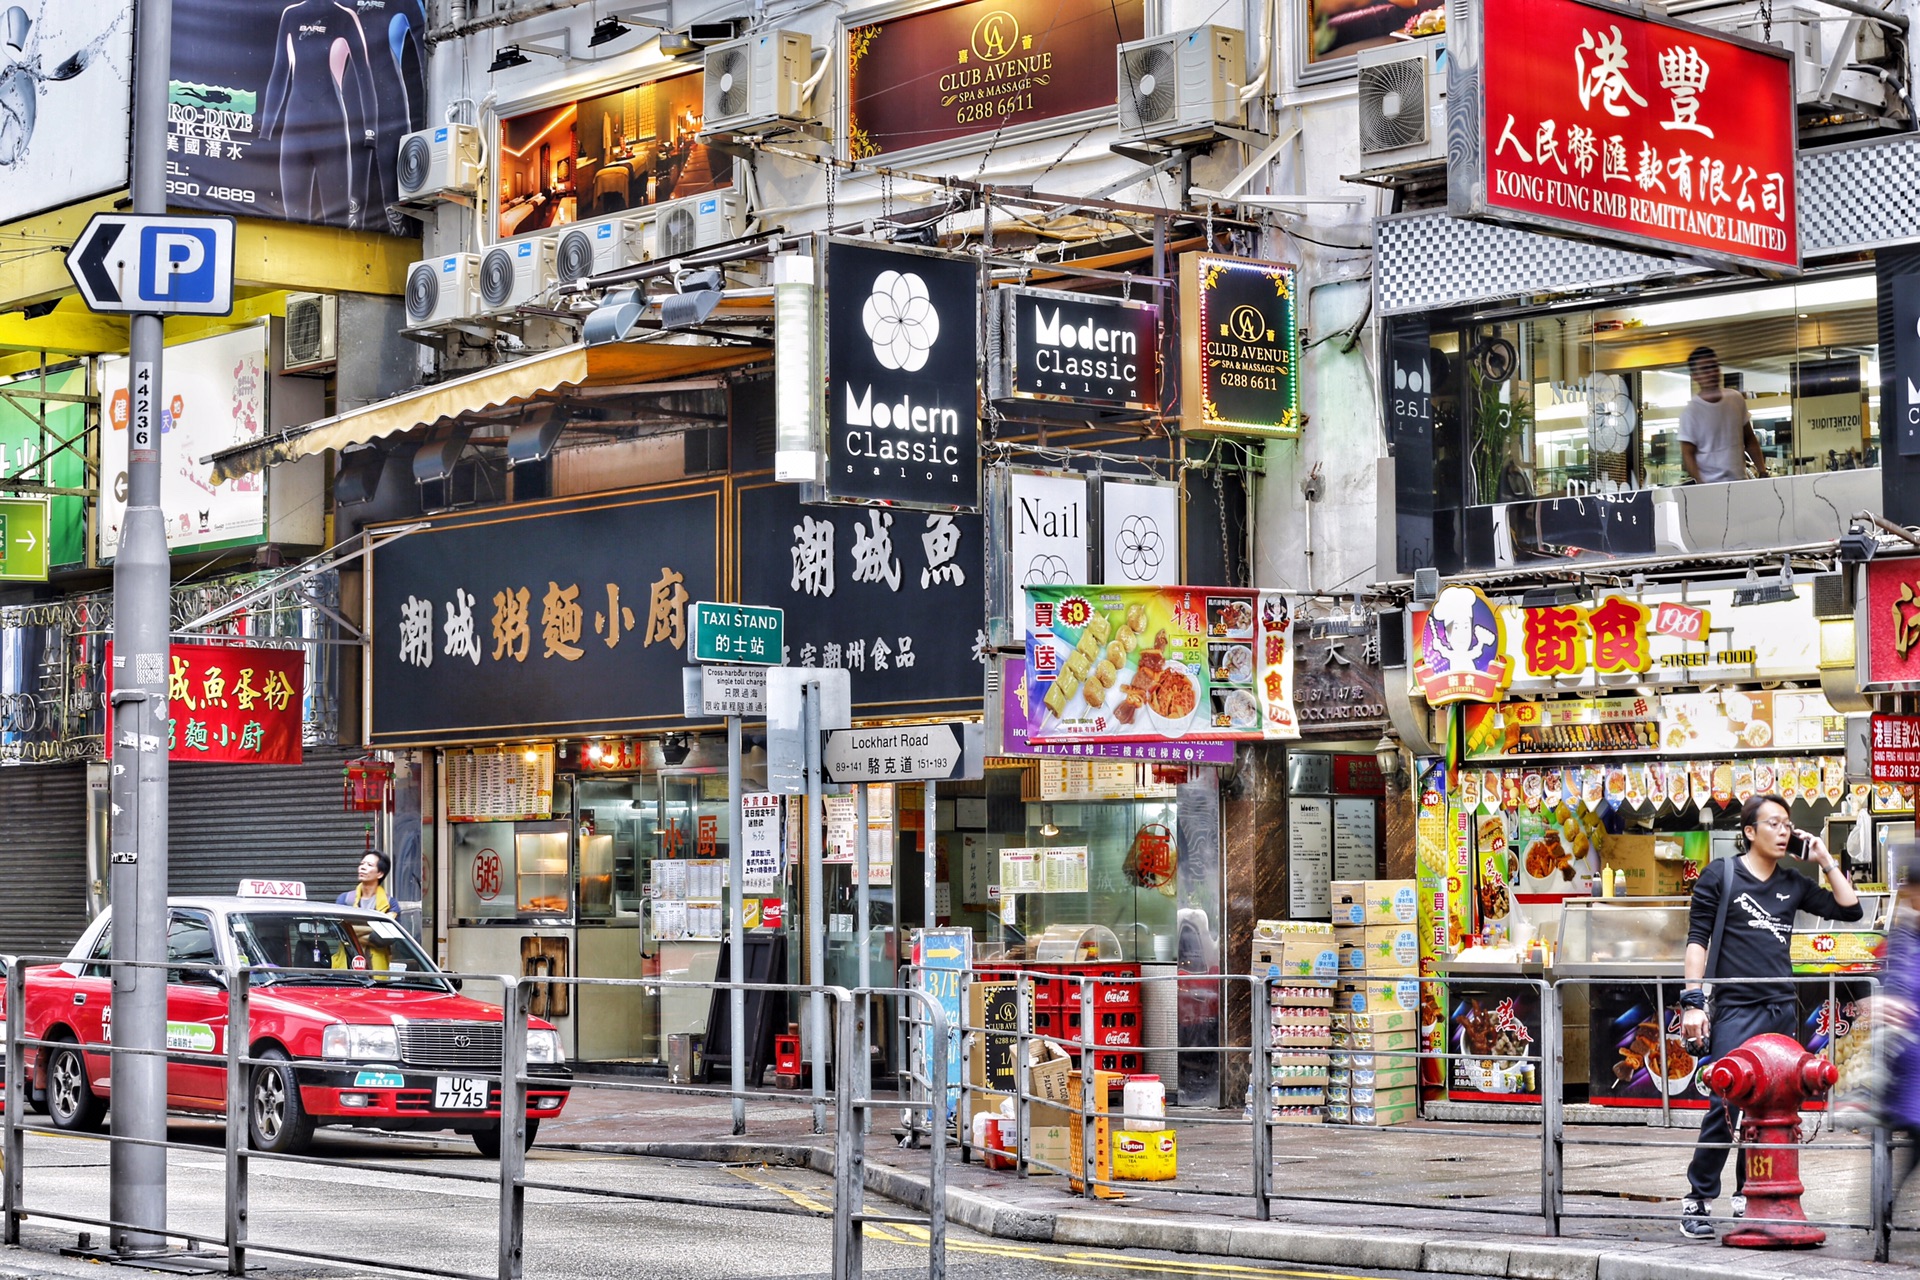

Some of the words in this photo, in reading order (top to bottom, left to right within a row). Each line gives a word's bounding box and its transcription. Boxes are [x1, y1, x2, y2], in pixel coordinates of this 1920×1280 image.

[939, 68, 981, 92] CLUB
[984, 52, 1053, 83] AVENUE
[1574, 24, 1715, 139] 港豐
[959, 91, 975, 103] SPA
[977, 88, 985, 99] &
[986, 78, 1032, 97] MASSAGE
[957, 101, 993, 124] 6288
[997, 93, 1034, 116] 6611
[167, 133, 243, 160] 美國潛水
[1495, 113, 1785, 222] 人民幣匯款有限公司
[206, 185, 255, 204] 4889
[1495, 169, 1544, 203] KONG
[1546, 179, 1590, 213] FUNG
[1593, 188, 1627, 219] RMB
[1629, 197, 1726, 240] REMITTANCE
[1727, 217, 1787, 252] LIMITED
[155, 233, 205, 295] P
[1035, 304, 1137, 355] Modern
[1207, 341, 1238, 358] CLUB
[1240, 345, 1290, 364] AVENUE
[1035, 349, 1137, 383] Classic
[1221, 359, 1234, 369] SPA
[1235, 361, 1241, 370] &
[1242, 362, 1275, 374] MASSAGE
[1220, 372, 1248, 388] 6288
[1250, 375, 1277, 391] 6611
[136, 368, 150, 444] 44236
[846, 380, 958, 436] Modern
[846, 430, 958, 466] Classic
[1018, 495, 1080, 539] Nail
[399, 567, 690, 668] 潮城粥麵小廚
[702, 611, 730, 626] TAXI
[734, 614, 778, 630] STAND
[1660, 607, 1701, 635] 1986
[1035, 603, 1056, 680] 買一送一
[1184, 638, 1198, 647] $12
[1525, 597, 1640, 672] 街食
[715, 634, 765, 656] 的士站
[1660, 653, 1710, 668] STREET
[1717, 650, 1756, 664] FOOD
[707, 668, 748, 677] Cross-harbour
[749, 669, 763, 678] trips
[717, 677, 734, 686] single
[734, 677, 745, 686] toll
[705, 701, 767, 712] 限收單程隧道通
[1354, 703, 1385, 718] ROAD
[851, 735, 898, 750] Lockhart
[900, 734, 929, 747] Road
[835, 762, 863, 773] 89-141
[867, 756, 914, 775] 駱克道
[917, 757, 948, 769] 151-193
[250, 880, 303, 897] TAXI
[352, 959, 366, 968] TAXI
[995, 1037, 1009, 1045] 6288
[364, 1078, 395, 1086] SEATS
[451, 1077, 473, 1093] UC
[440, 1092, 483, 1108] 7745
[1047, 1129, 1059, 1139] 44
[1121, 1143, 1144, 1151] Lipton
